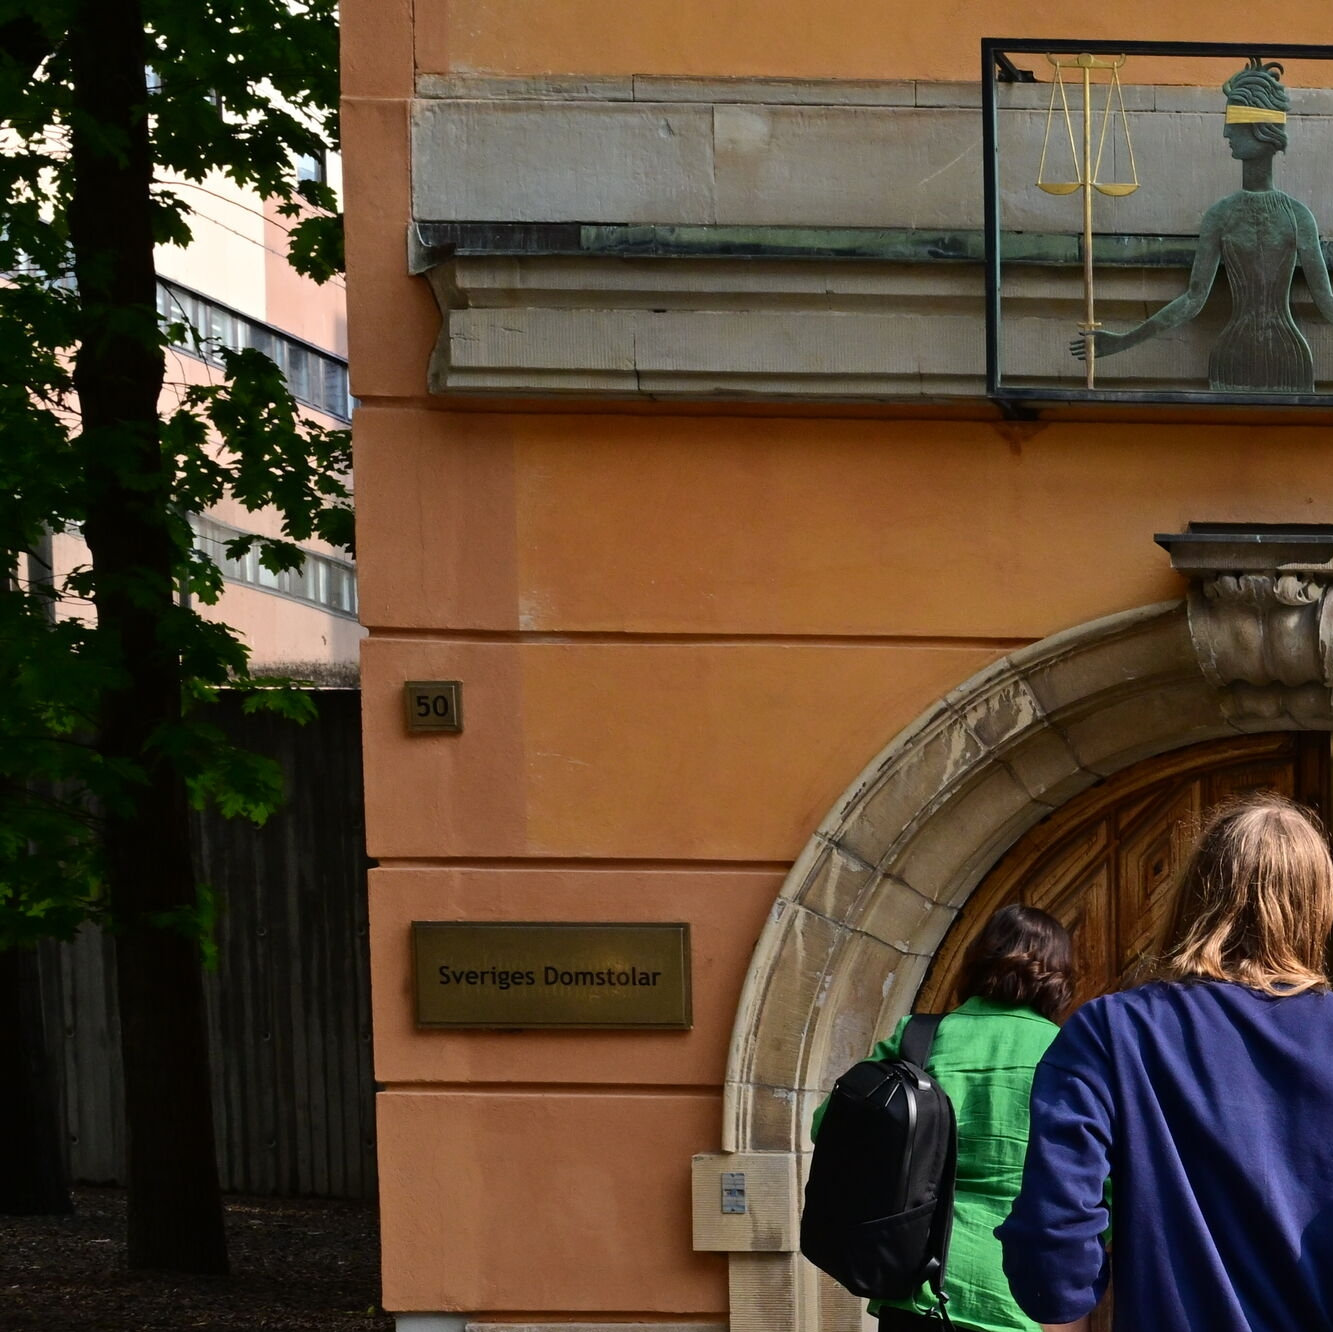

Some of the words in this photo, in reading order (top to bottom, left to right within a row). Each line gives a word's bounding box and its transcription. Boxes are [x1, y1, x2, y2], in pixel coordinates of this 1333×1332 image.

[416, 695, 449, 717] 50
[439, 966, 535, 990] Sveriges
[544, 966, 662, 987] Domstolar
